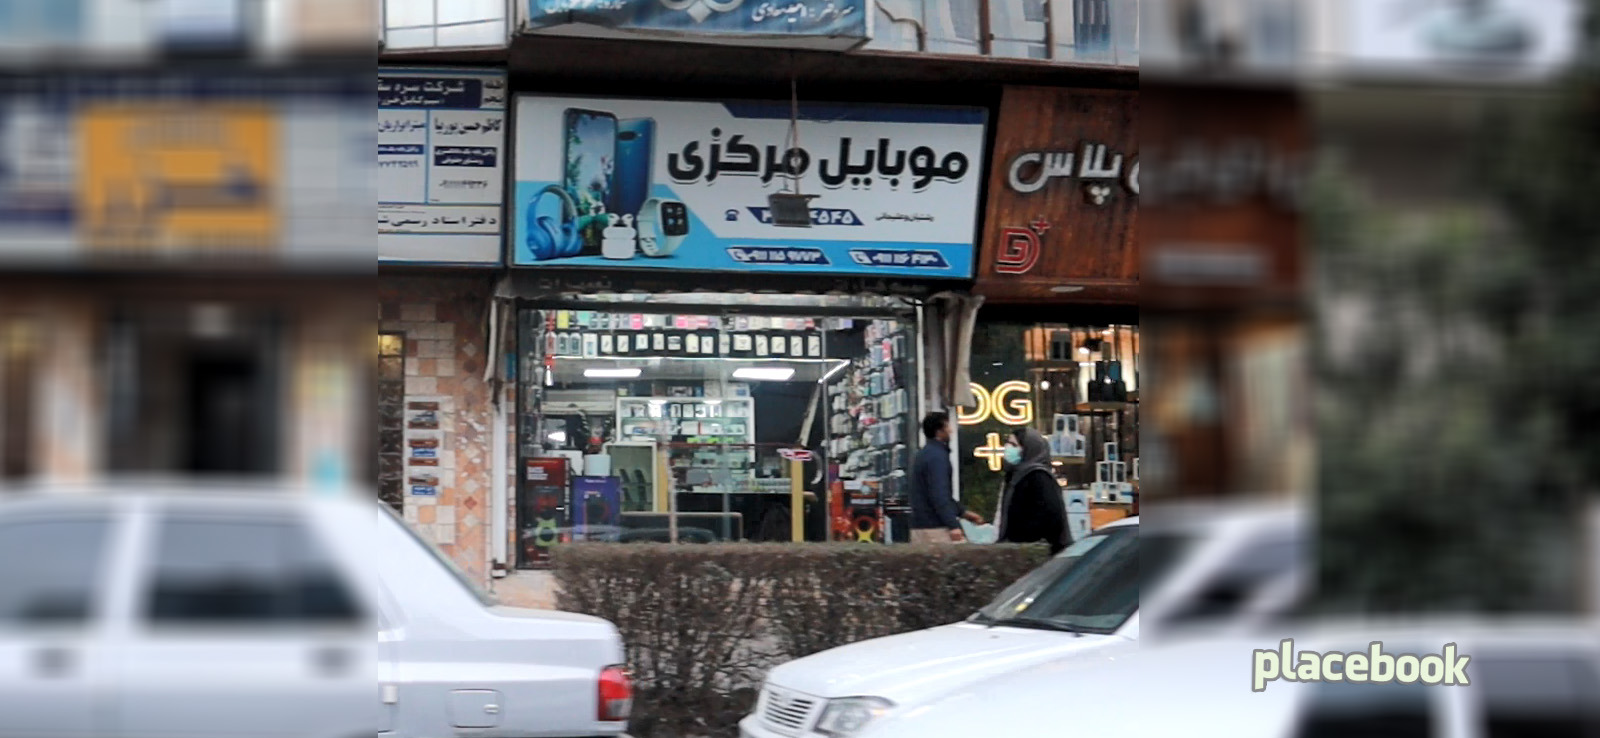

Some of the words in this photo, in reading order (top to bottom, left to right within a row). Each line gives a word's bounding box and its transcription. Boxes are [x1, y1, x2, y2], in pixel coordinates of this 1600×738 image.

[421, 80, 464, 96] شرکت
[666, 126, 811, 187] مرکزی
[818, 136, 969, 192] موبایل
[1009, 143, 1122, 205] پلاس
[957, 380, 1034, 426] DG
